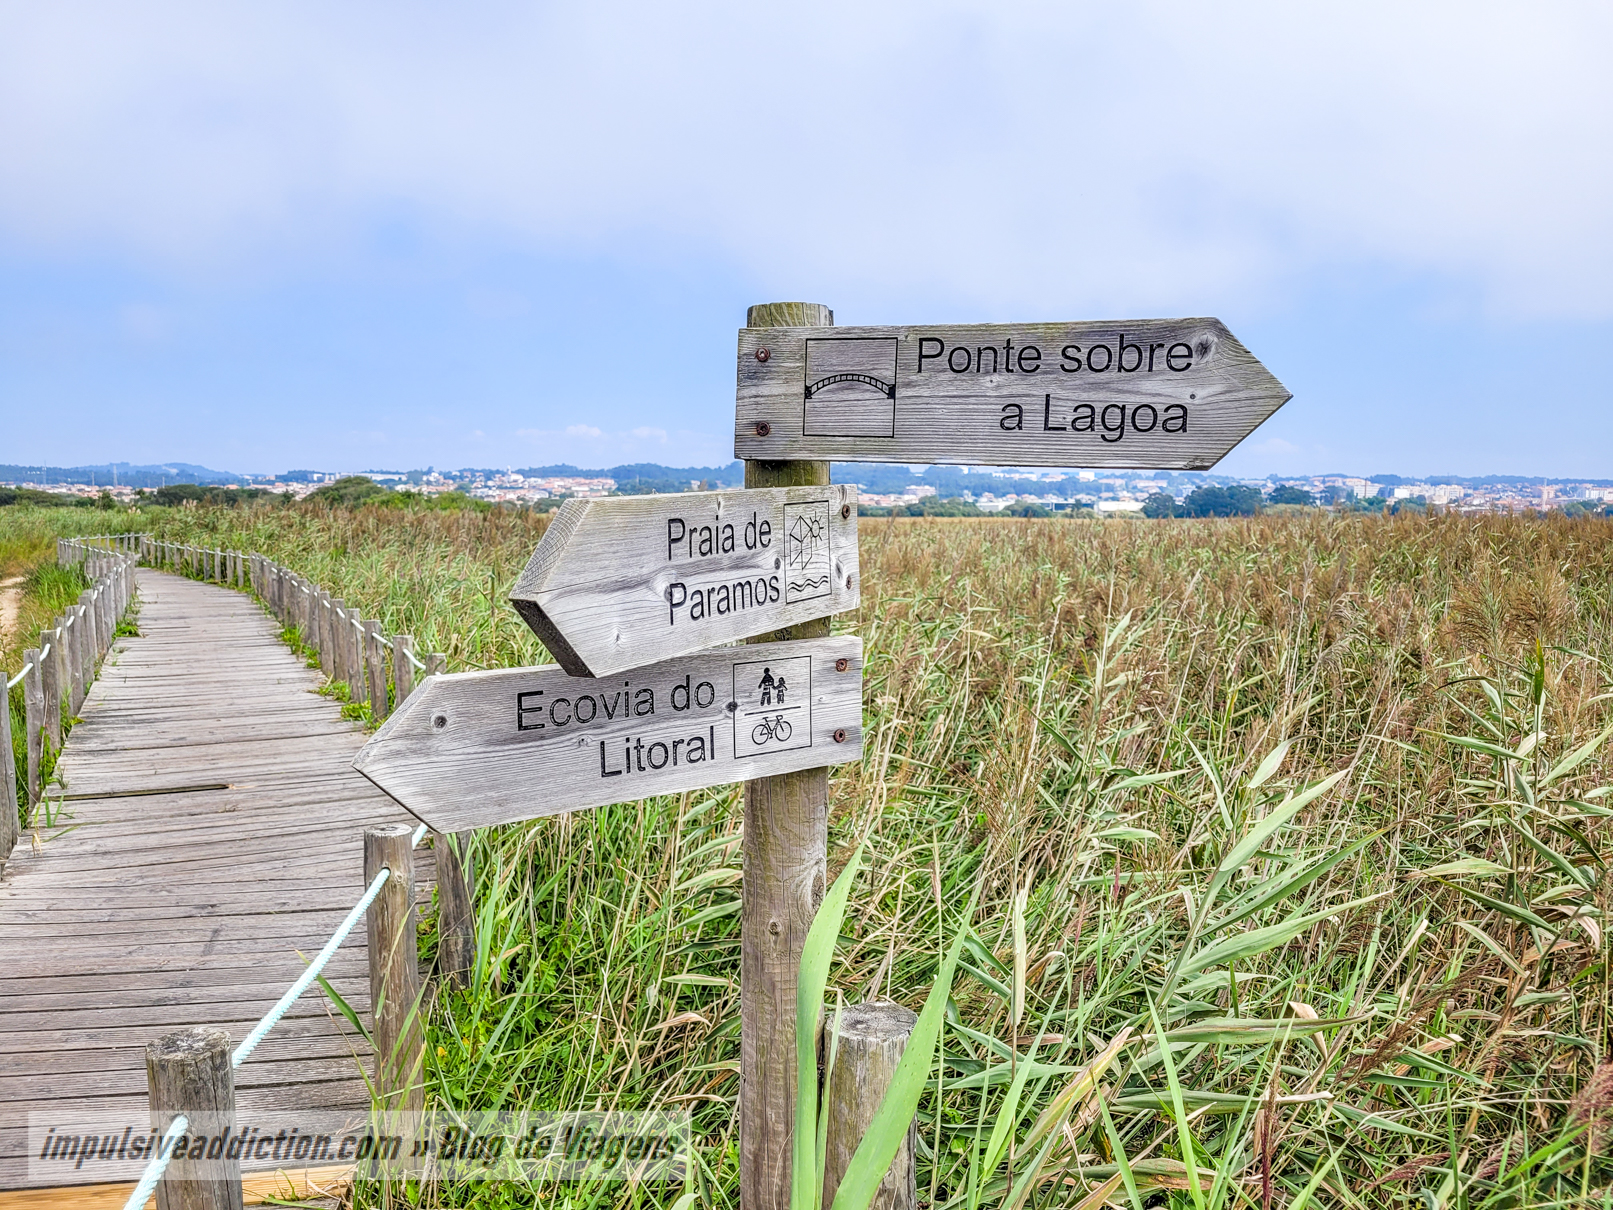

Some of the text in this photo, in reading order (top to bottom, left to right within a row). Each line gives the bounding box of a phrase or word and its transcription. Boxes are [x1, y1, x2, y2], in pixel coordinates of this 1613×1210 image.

[917, 333, 1194, 374] Ponte sobre
[1000, 394, 1188, 442] a Lagoa
[667, 511, 772, 561] Praia de
[669, 575, 780, 626] Paramos
[517, 674, 715, 731] Ecovia do
[600, 725, 715, 777] Litoral
